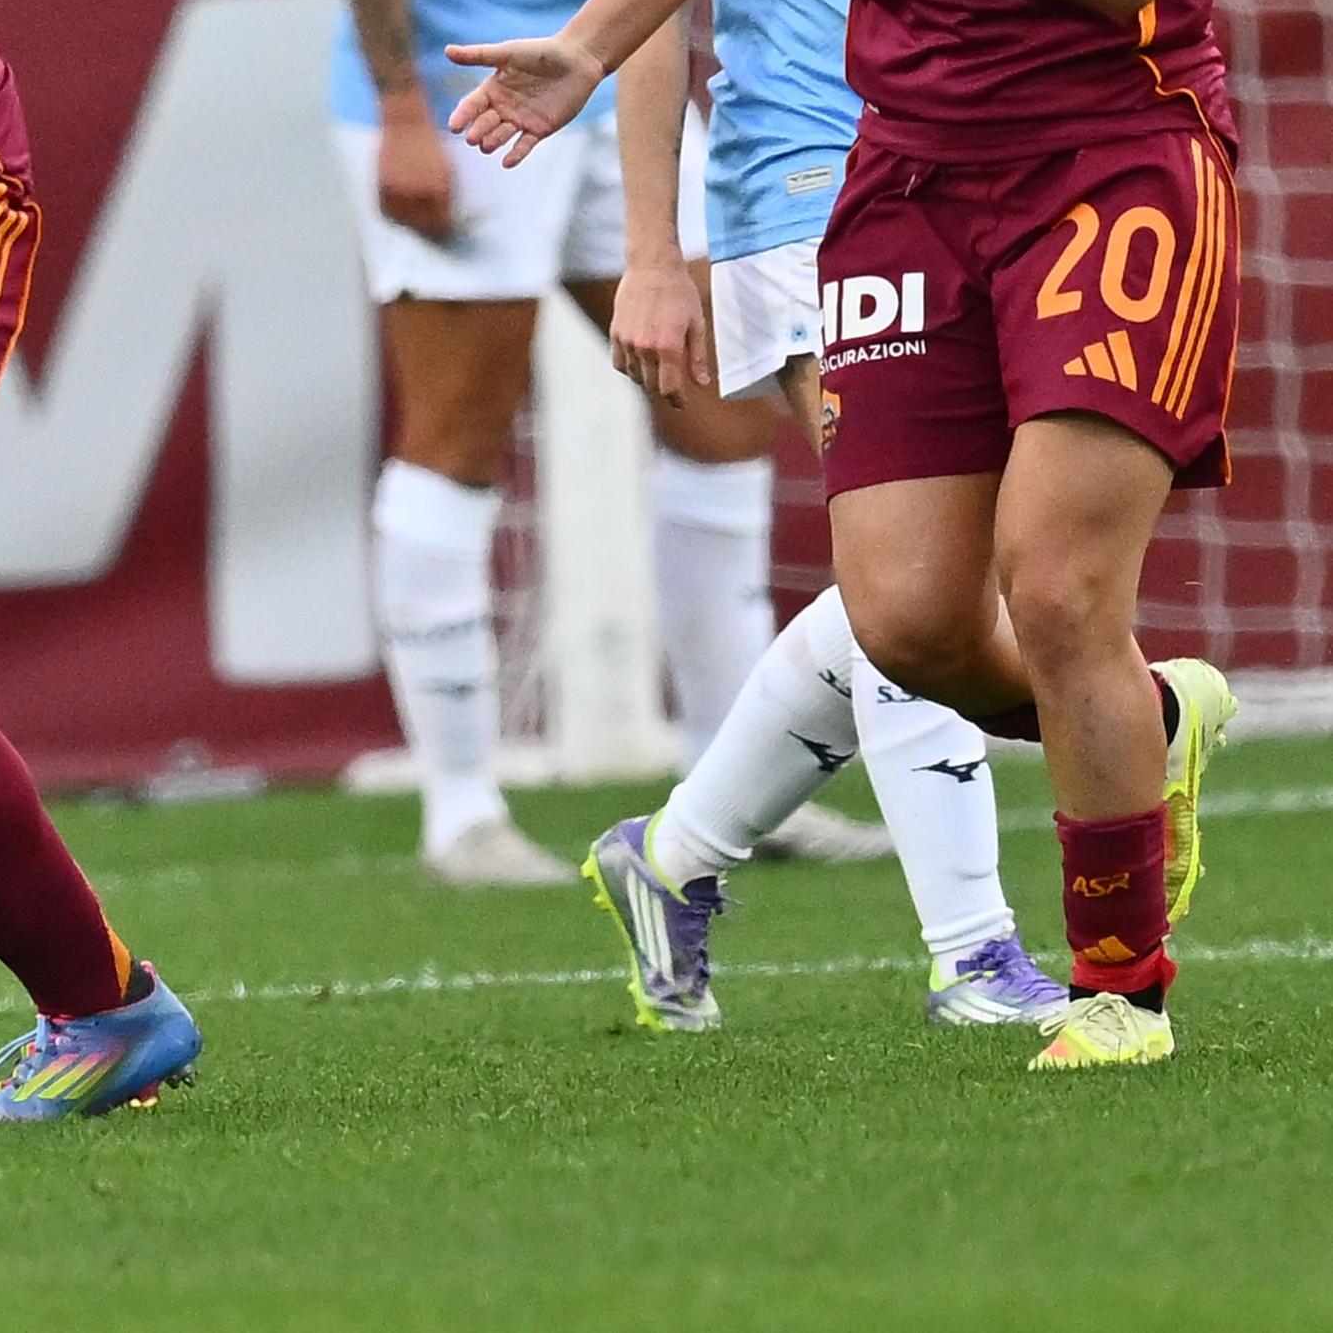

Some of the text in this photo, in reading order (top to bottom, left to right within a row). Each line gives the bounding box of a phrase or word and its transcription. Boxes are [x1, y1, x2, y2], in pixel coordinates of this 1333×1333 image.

[1036, 203, 1176, 323] 20
[819, 339, 927, 376] SICURAZIONI
[1072, 872, 1130, 898] ASR
